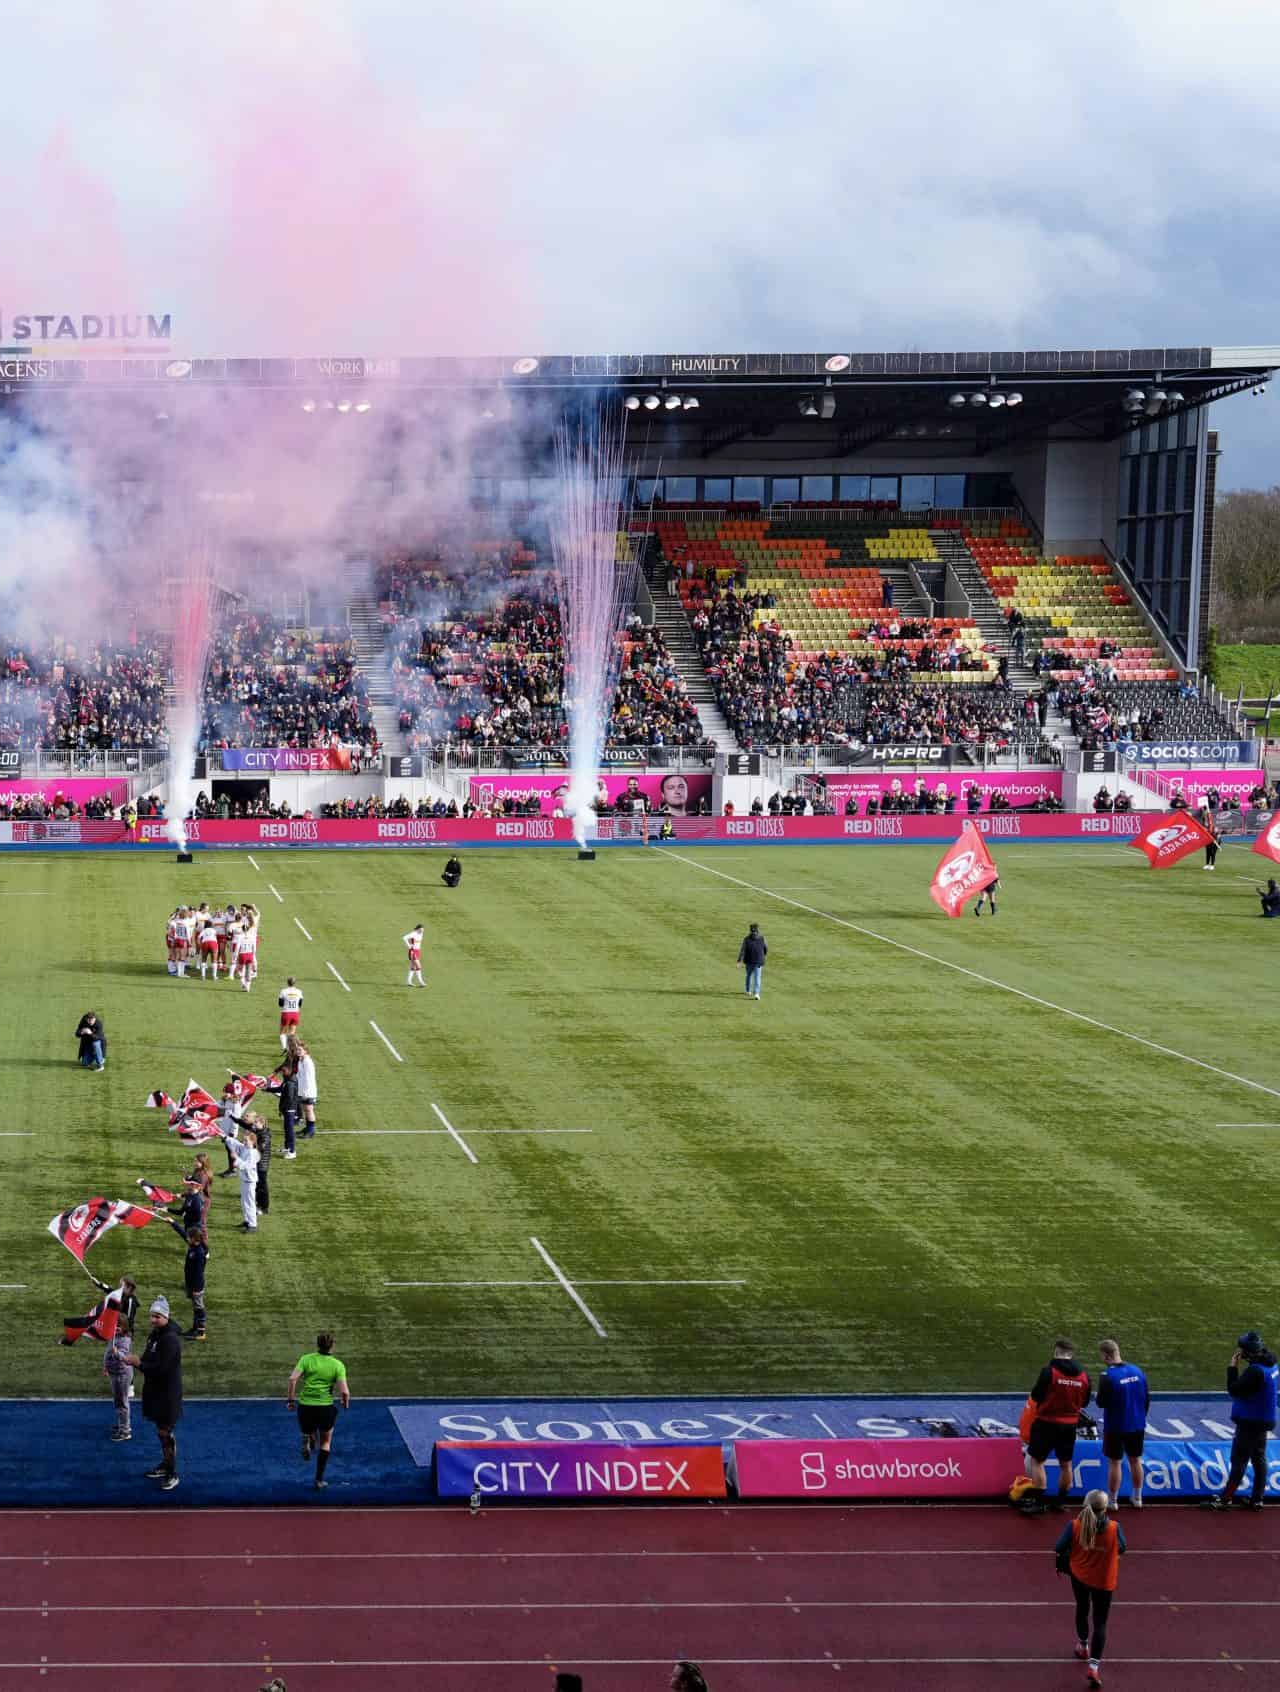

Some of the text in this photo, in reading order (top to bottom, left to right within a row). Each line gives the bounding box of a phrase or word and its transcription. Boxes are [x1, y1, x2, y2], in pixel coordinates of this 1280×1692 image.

[13, 315, 171, 339] STADIUM
[672, 359, 741, 371] HUMILITY
[245, 753, 329, 766] CITY INDEX
[872, 748, 942, 759] HY-PRO
[1141, 745, 1239, 758] socios.com
[498, 787, 551, 799] shawbro
[260, 822, 318, 840] RED ROSES
[378, 821, 436, 839] RED ROSES
[496, 820, 554, 838] RED ROSES
[727, 818, 784, 837] RED ROSES
[844, 817, 902, 836] RED ROSES
[992, 816, 1020, 835] ROSES
[1081, 815, 1141, 834] RED ROSES
[439, 1413, 796, 1442] StoneX
[474, 1460, 690, 1492] CITY INDEX
[835, 1458, 962, 1480] shawbrook
